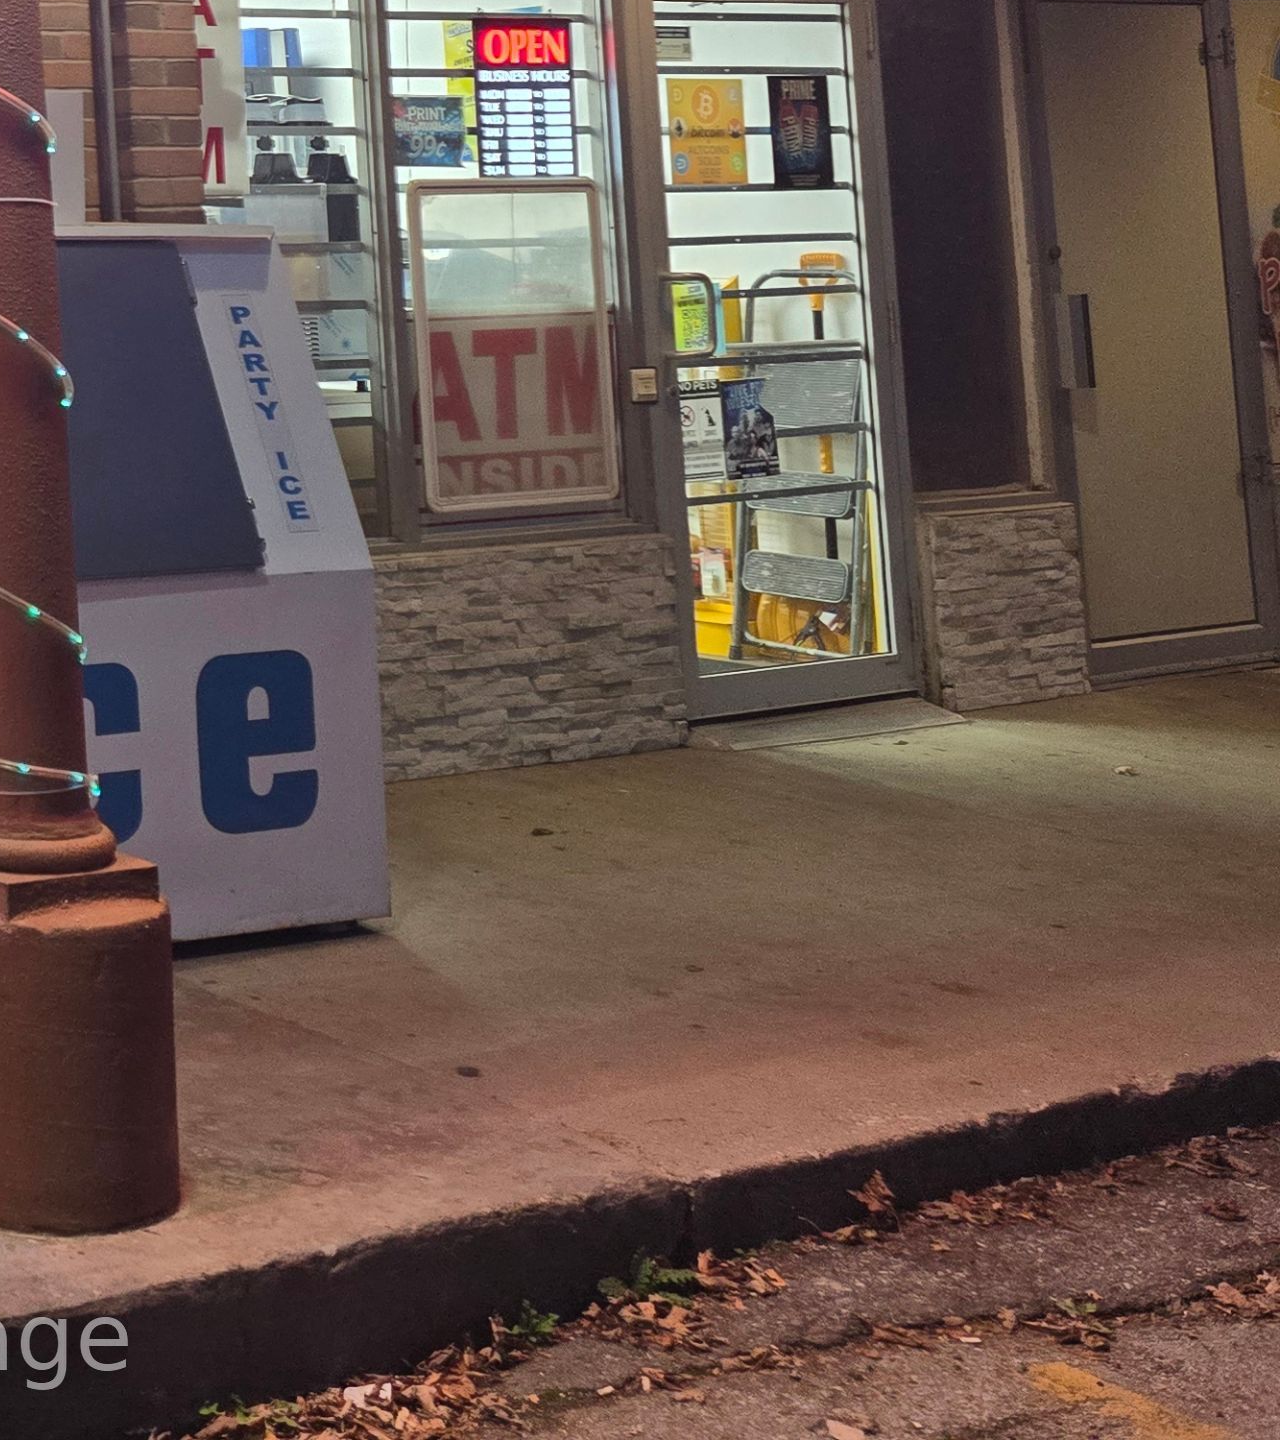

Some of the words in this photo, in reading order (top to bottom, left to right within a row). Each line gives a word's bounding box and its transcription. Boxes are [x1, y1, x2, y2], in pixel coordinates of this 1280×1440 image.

[482, 28, 568, 65] OPEN
[478, 70, 529, 83] BUSINESS
[531, 70, 571, 83] HOURS
[781, 79, 817, 100] PRIME
[407, 106, 446, 121] PRINT
[693, 379, 718, 392] PETS
[230, 305, 280, 422] PARTY
[276, 451, 312, 521] ICE
[439, 454, 607, 497] NSID
